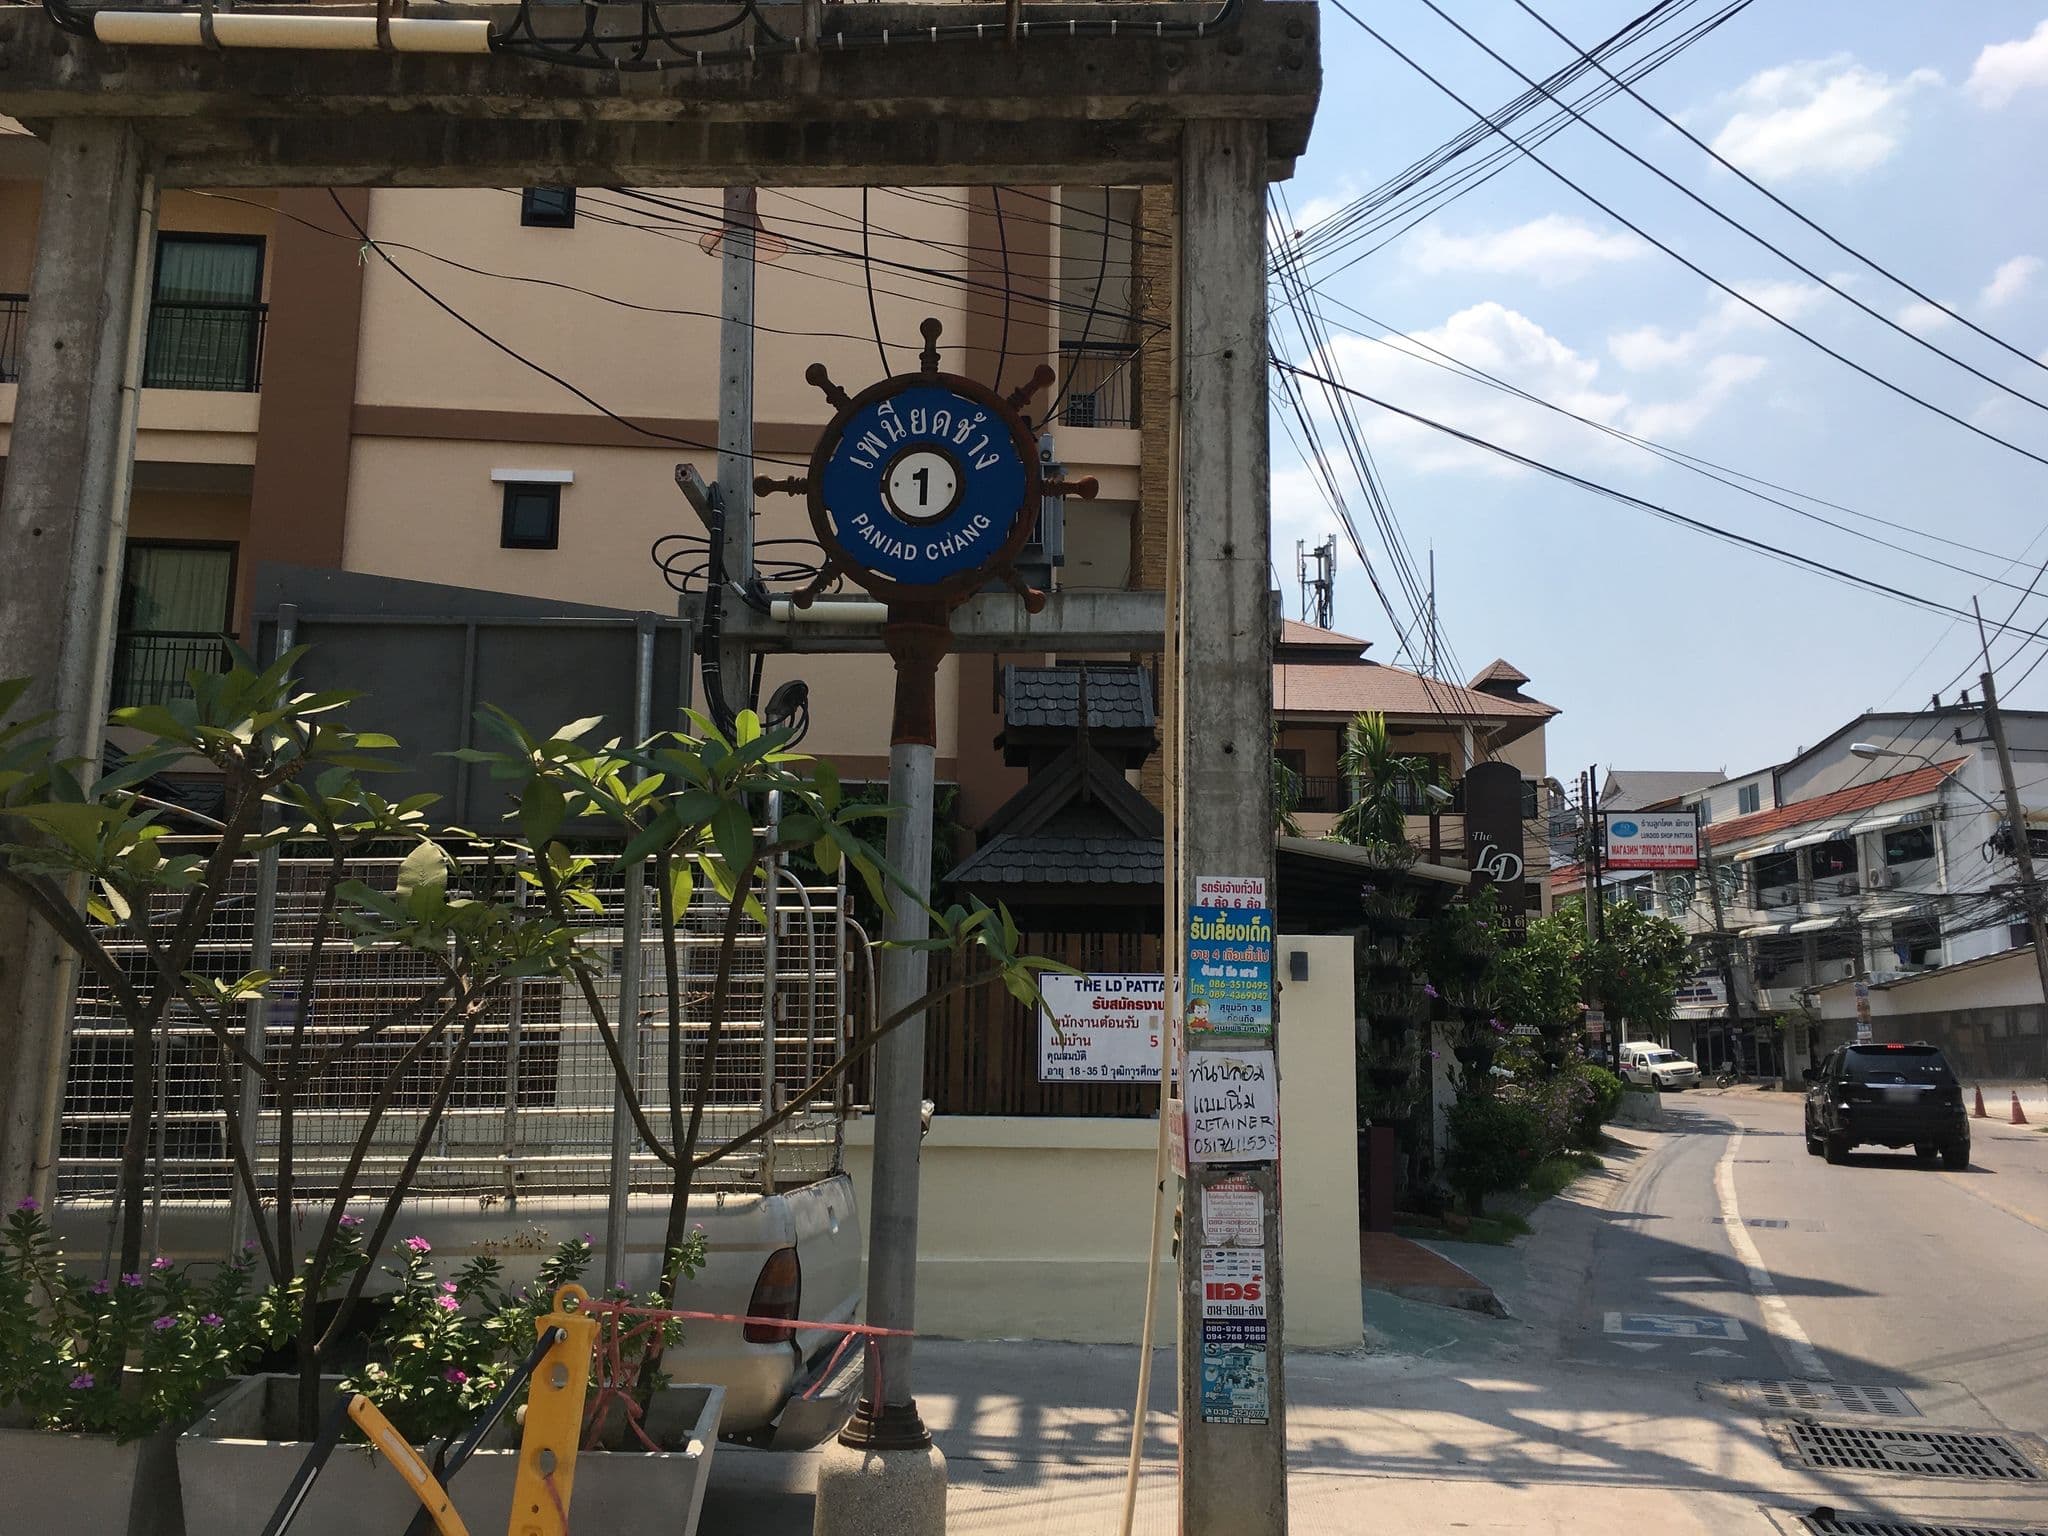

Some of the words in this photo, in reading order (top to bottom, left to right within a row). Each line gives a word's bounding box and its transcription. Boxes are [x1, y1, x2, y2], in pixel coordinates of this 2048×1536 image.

[850, 400, 1000, 470] เพนียดช้าง
[912, 467, 929, 506] 1
[851, 513, 917, 561] PANIAD
[925, 513, 992, 561] CHANG
[1472, 831, 1493, 841] The
[1471, 844, 1523, 882] LD
[1201, 880, 1263, 895] รถรับจ้างทั่วไป
[1201, 897, 1209, 908] 4
[1233, 898, 1241, 909] 6
[1190, 910, 1271, 943] รับเลี้ยงเด็ก
[1191, 949, 1210, 964] อายุ
[1212, 949, 1220, 960] 4
[1074, 980, 1101, 992] THE
[1106, 980, 1122, 992] LD
[1150, 1035, 1158, 1047] 5
[1047, 1067, 1064, 1078] อายุ
[1111, 1064, 1161, 1079] วุฒิการศึกษ
[1194, 1084, 1255, 1113] แบบนิ่ม
[1194, 1115, 1274, 1133] RETAINER
[1206, 1274, 1263, 1301] แอร์
